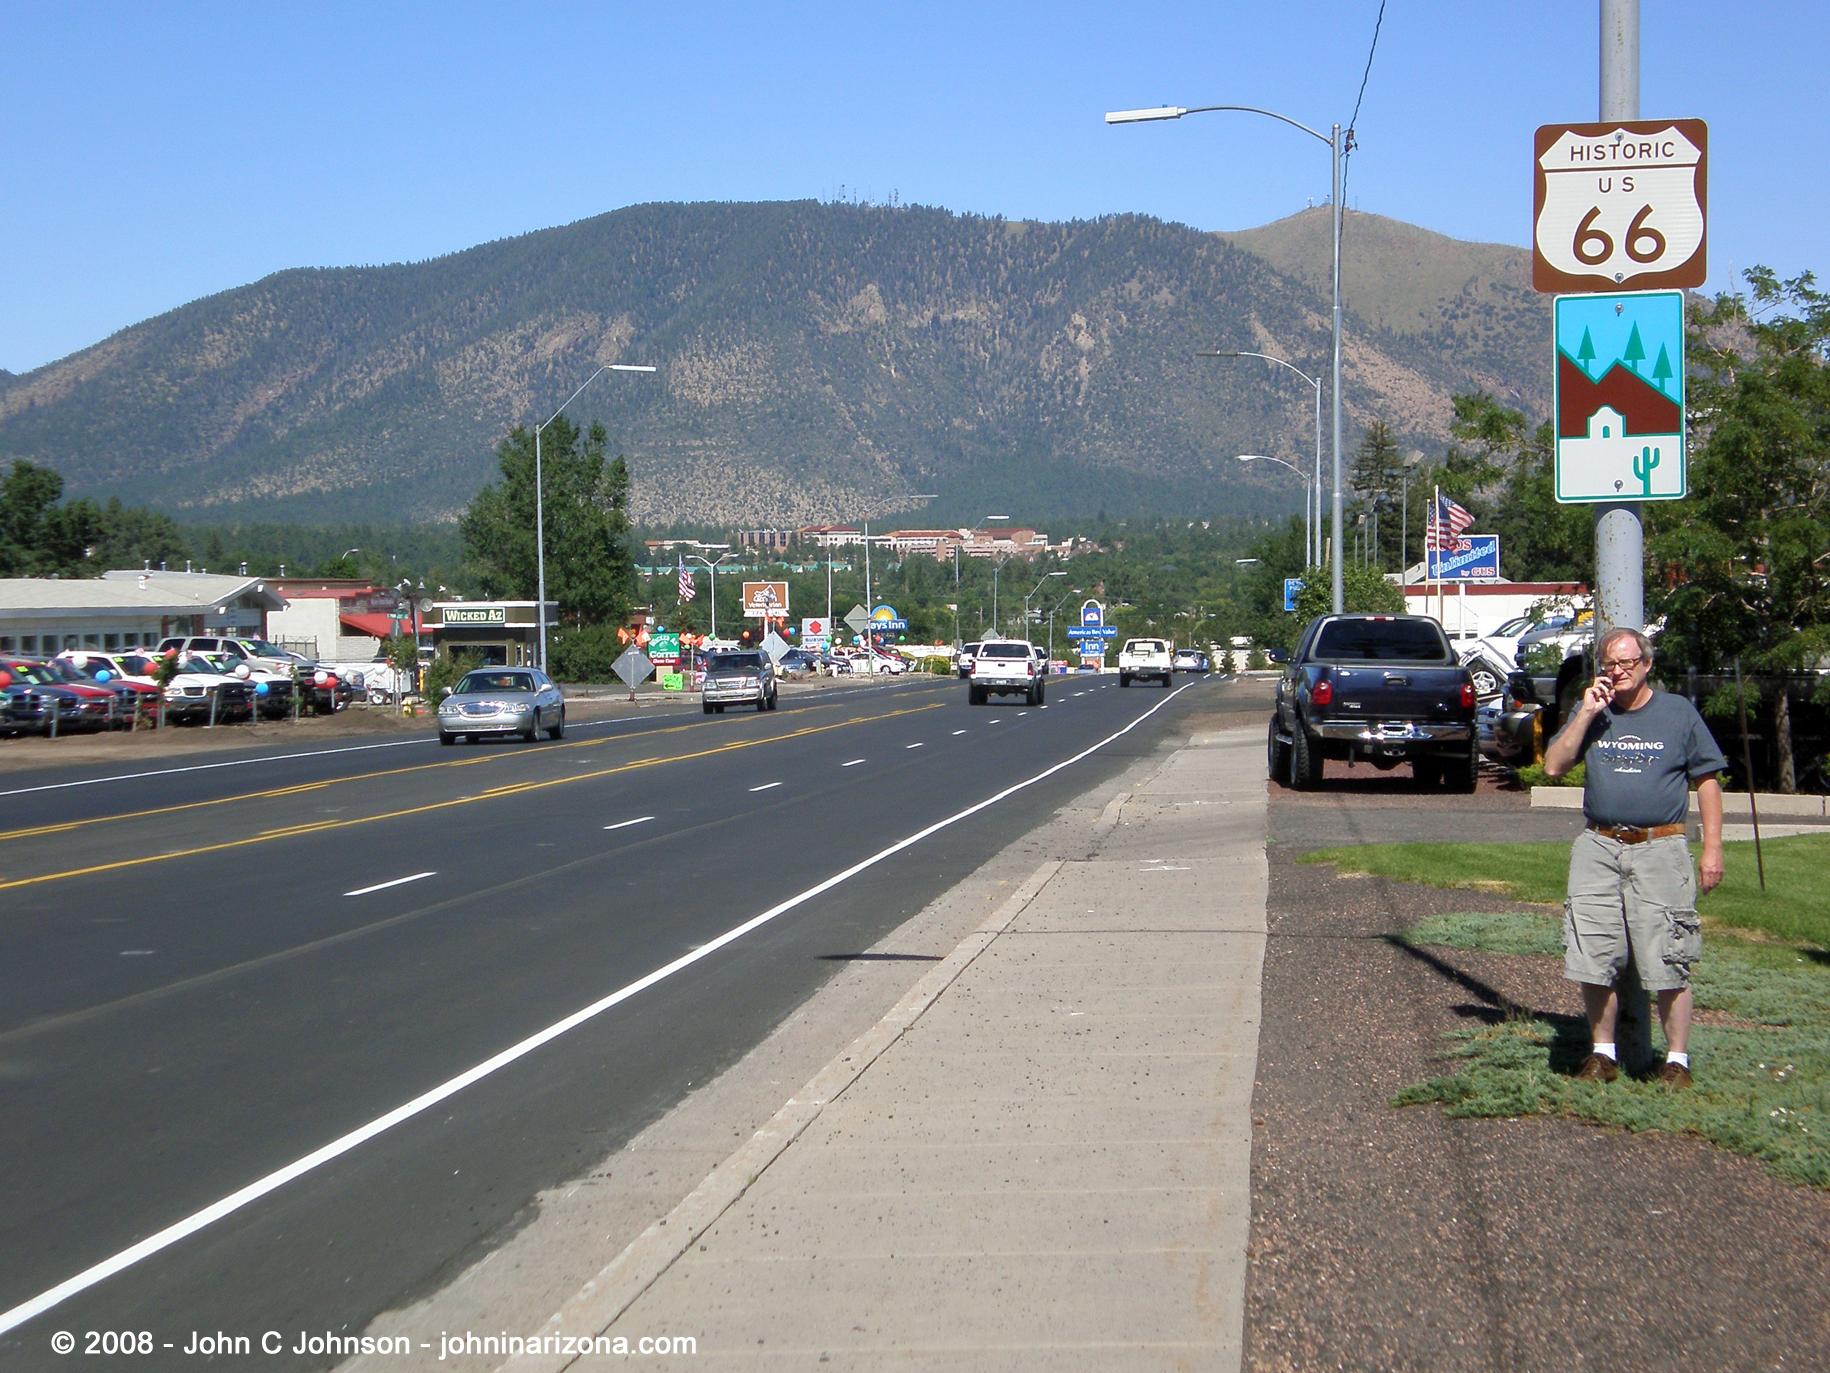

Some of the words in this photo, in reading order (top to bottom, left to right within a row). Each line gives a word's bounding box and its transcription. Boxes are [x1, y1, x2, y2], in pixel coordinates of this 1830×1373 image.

[1570, 140, 1675, 162] HISTORIC
[1571, 203, 1666, 266] 66
[1431, 540, 1496, 576] Unlimited
[1471, 567, 1495, 576] GUS
[888, 621, 906, 629] Inn
[1085, 642, 1099, 651] Inn
[1597, 740, 1665, 750] WYOMING
